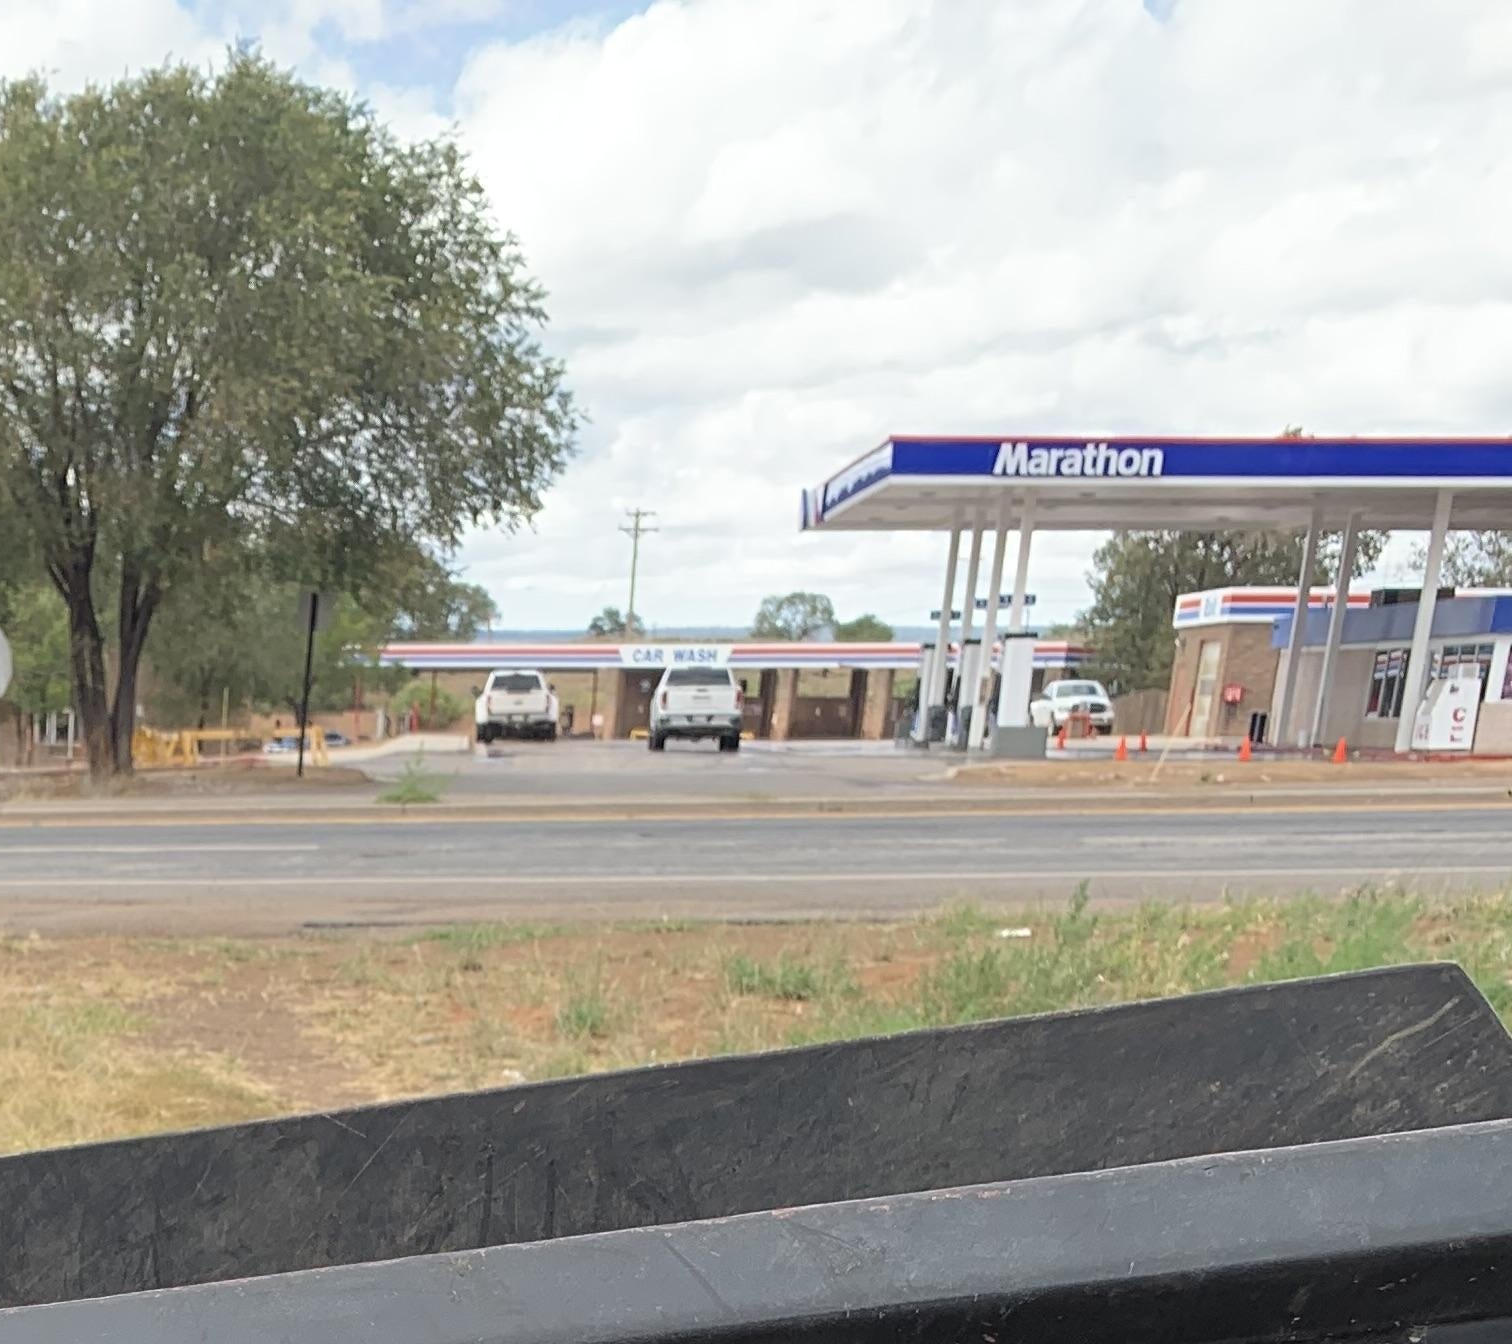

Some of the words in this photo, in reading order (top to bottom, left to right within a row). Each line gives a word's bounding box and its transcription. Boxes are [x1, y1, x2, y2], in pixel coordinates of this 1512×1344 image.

[992, 442, 1164, 476] Marathon
[632, 648, 664, 662] CAR
[673, 648, 718, 662] WASH
